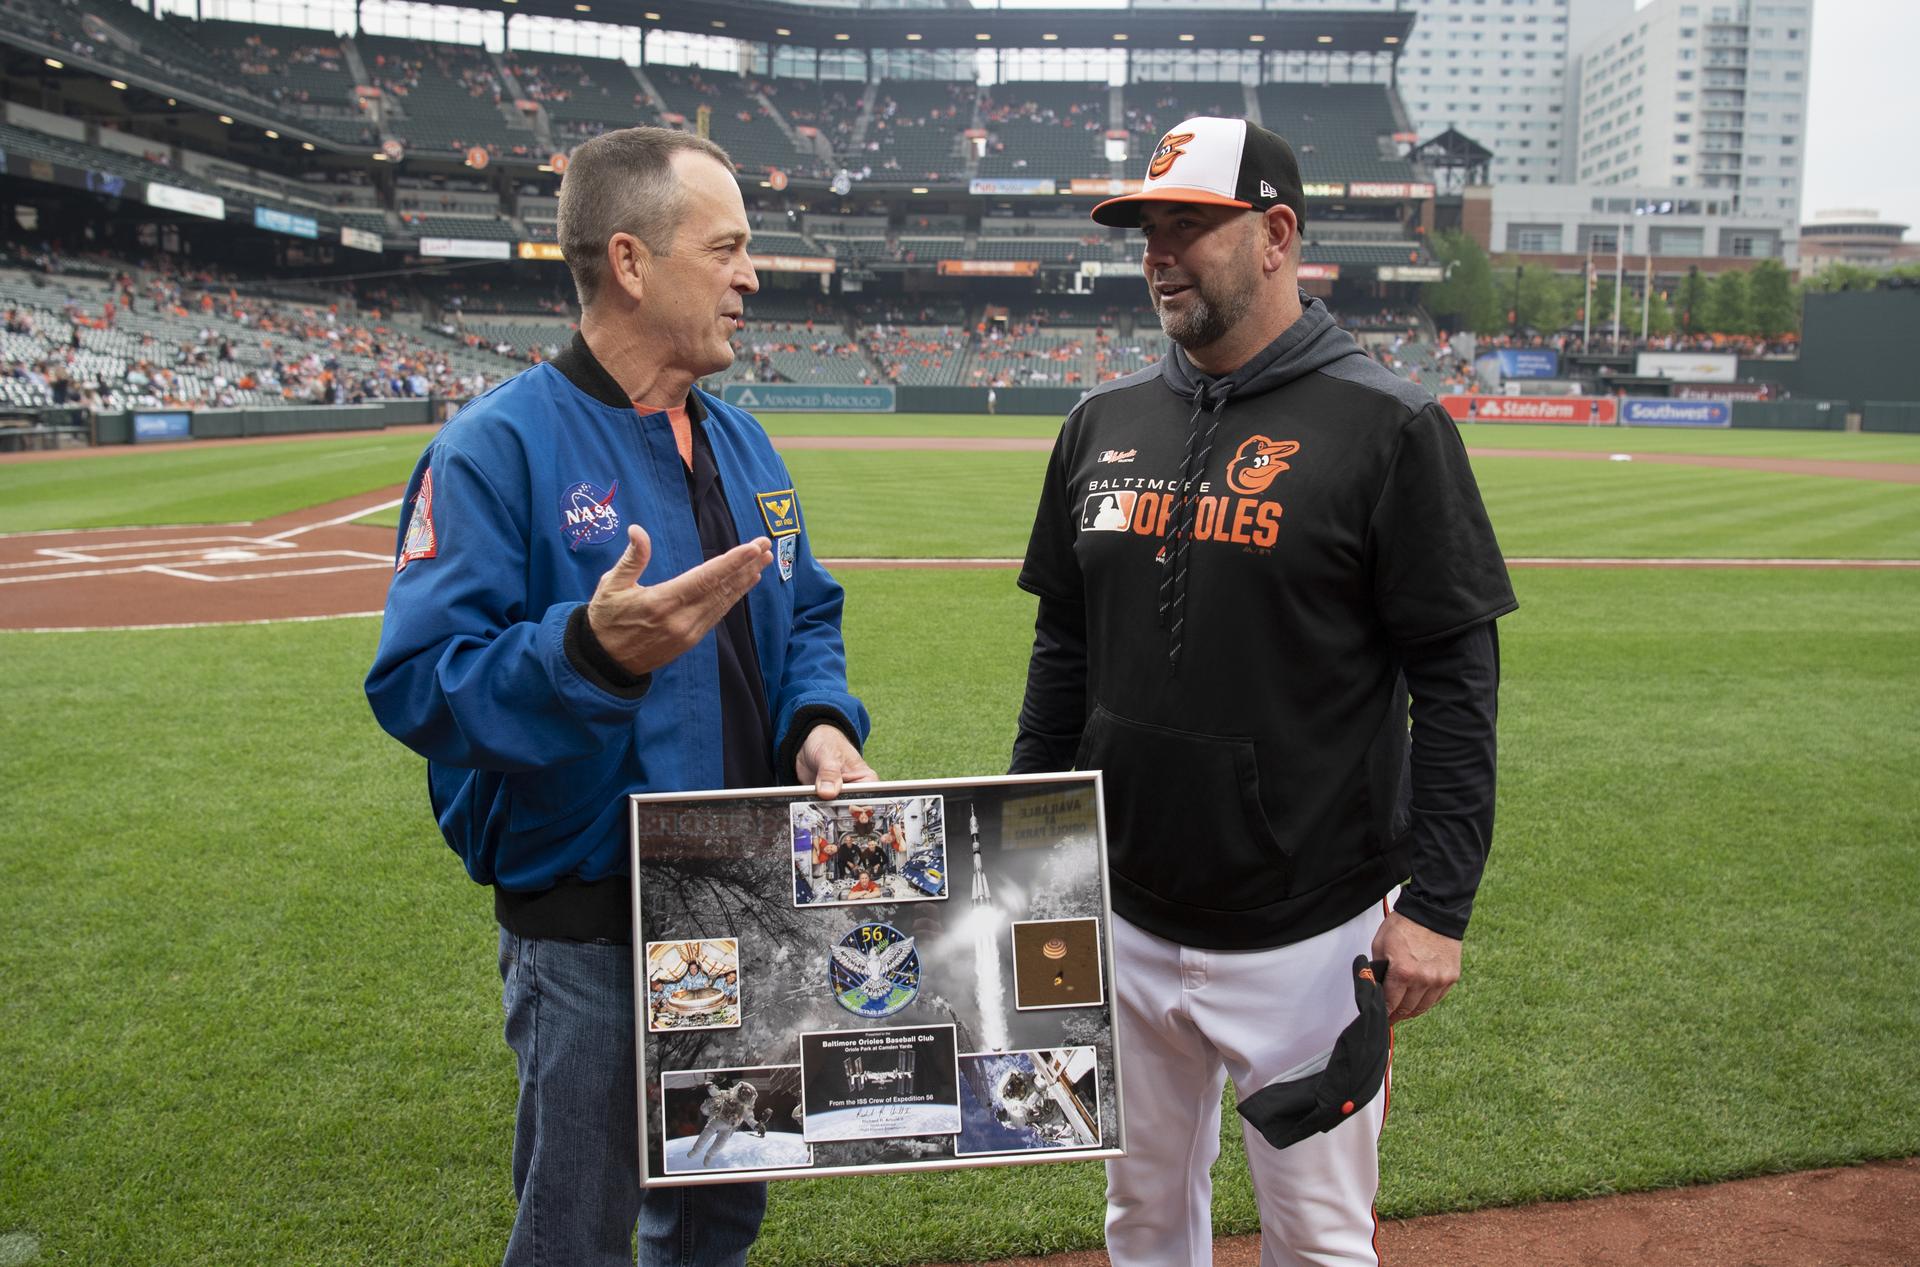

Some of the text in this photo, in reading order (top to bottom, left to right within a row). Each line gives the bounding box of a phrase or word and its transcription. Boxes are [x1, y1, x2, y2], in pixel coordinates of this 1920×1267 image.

[763, 393, 882, 407] ADVANCED RADIOLOGY
[1631, 404, 1709, 420] Southwest
[565, 504, 617, 526] NASA
[862, 926, 883, 942] 56
[822, 1040, 857, 1048] Baltimore
[858, 1038, 884, 1046] Orioles
[885, 1036, 916, 1044] Baseball
[893, 1095, 925, 1103] Expedition
